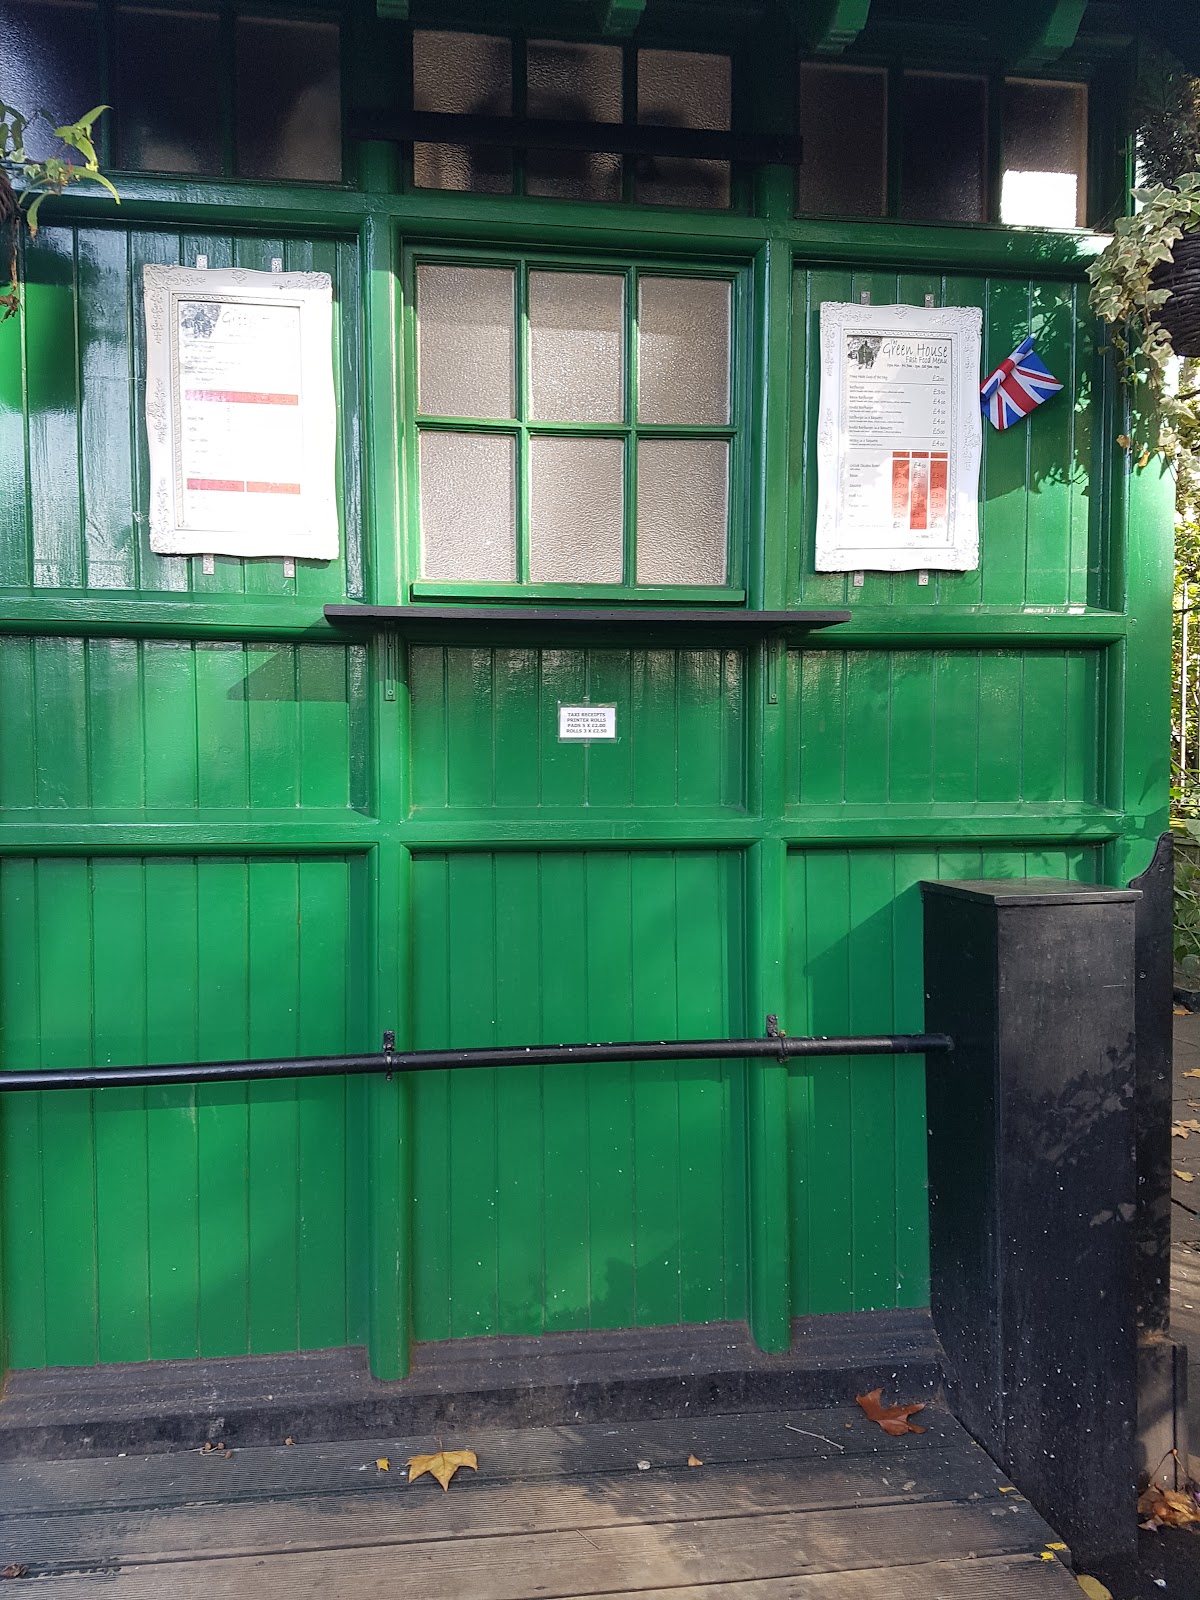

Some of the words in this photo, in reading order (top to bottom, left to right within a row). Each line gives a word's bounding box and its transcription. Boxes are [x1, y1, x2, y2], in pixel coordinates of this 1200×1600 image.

[883, 343, 913, 358] Green
[917, 343, 948, 358] House
[905, 355, 917, 364] Fast
[918, 356, 931, 364] Food
[932, 357, 948, 365] Menu
